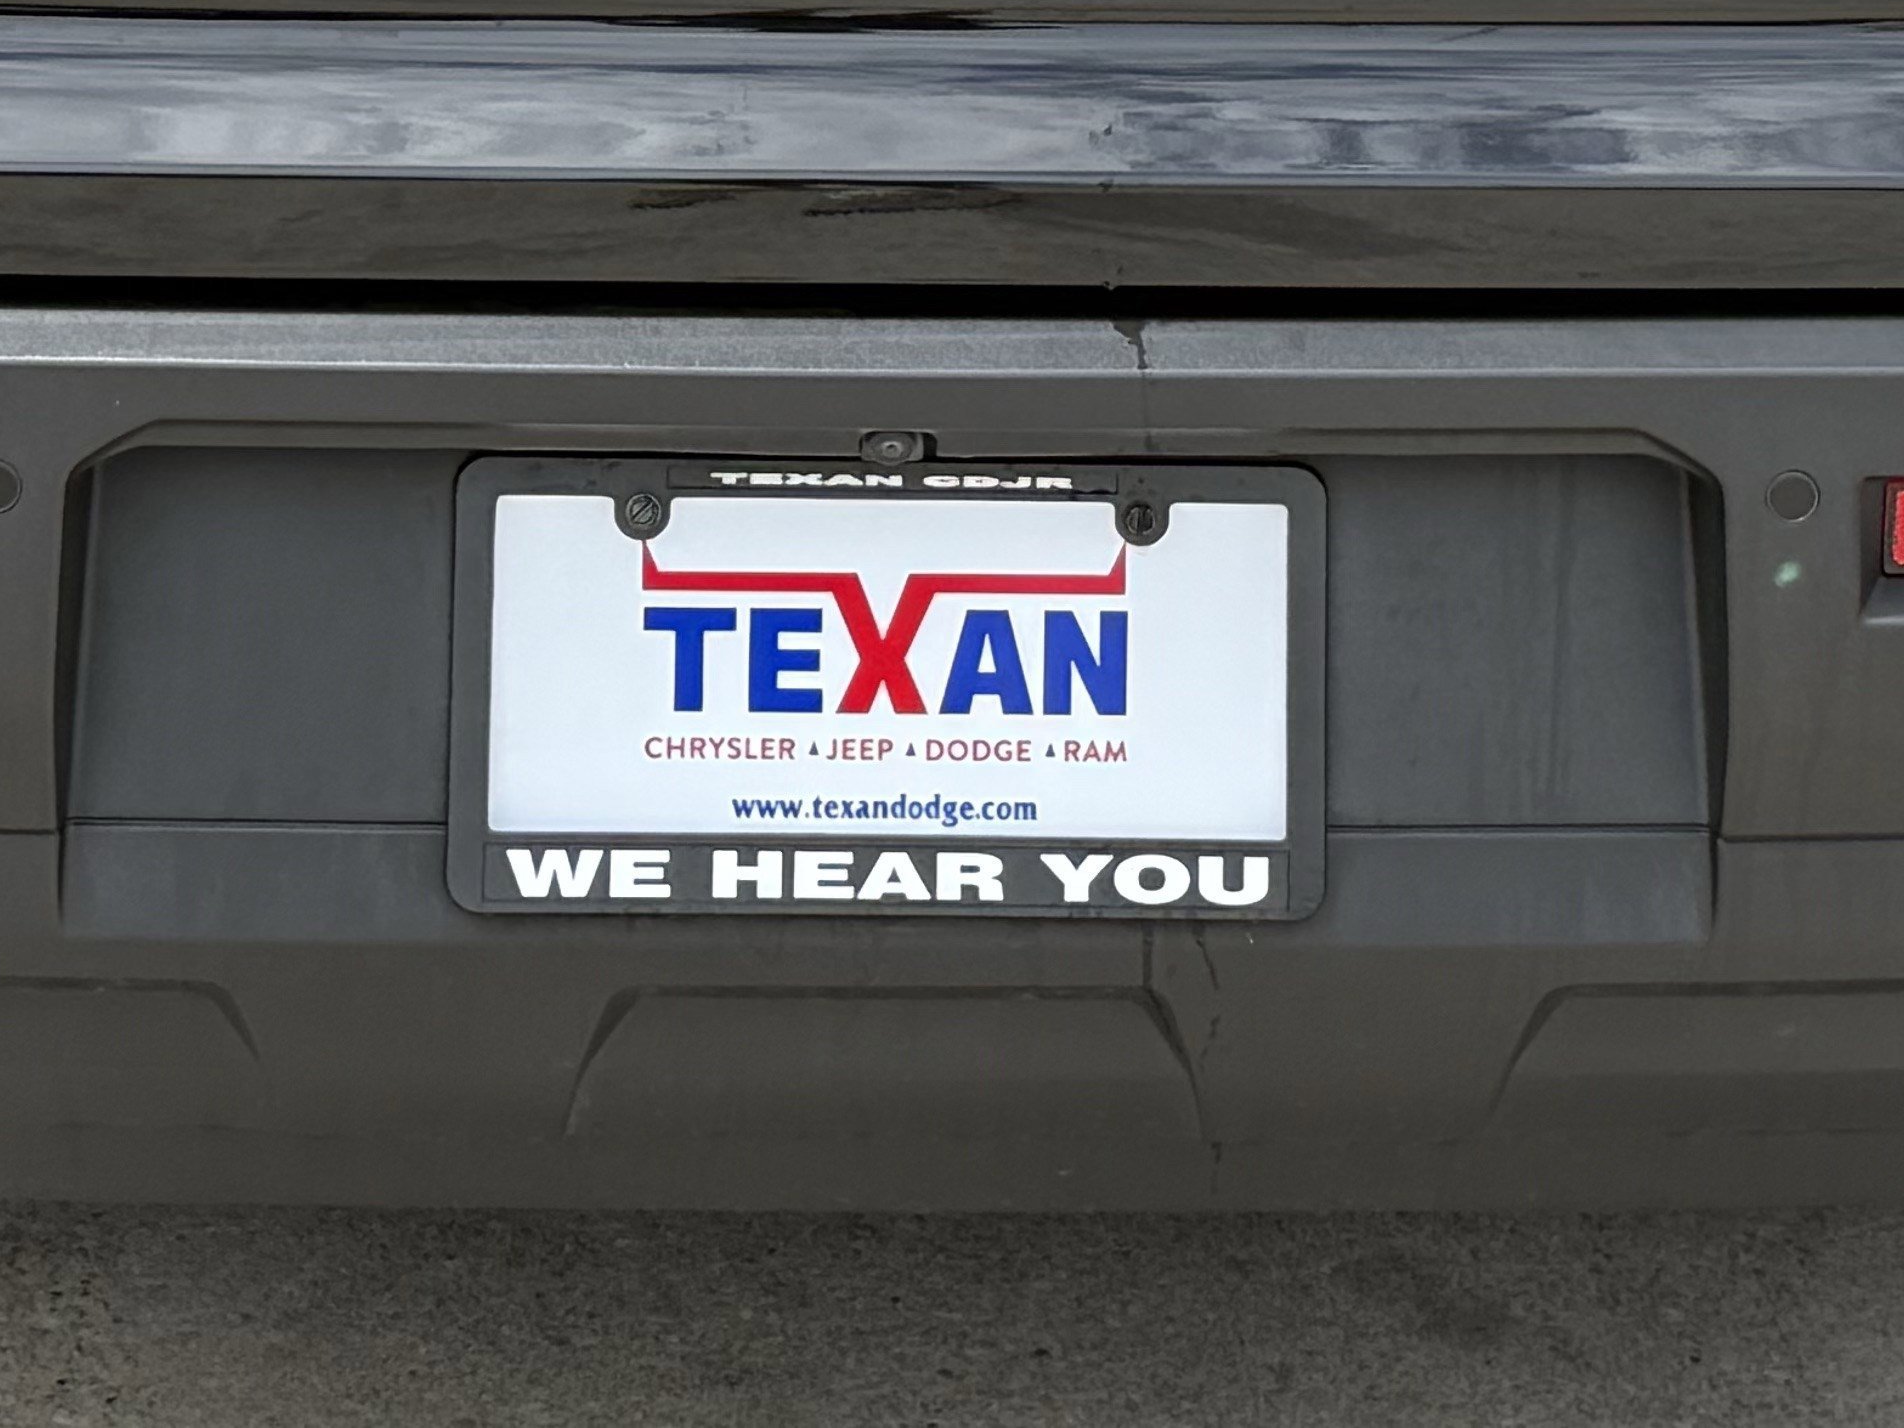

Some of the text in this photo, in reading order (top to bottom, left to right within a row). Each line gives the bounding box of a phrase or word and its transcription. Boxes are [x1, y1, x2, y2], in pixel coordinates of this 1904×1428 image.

[709, 471, 904, 488] TEXAN
[642, 541, 1129, 717] TEXAN
[643, 736, 1128, 764] CHRYSLER JEEP DODGE RAM
[731, 793, 1038, 828] www.texandodge.com
[504, 848, 1271, 907] WE HEAR YOU
